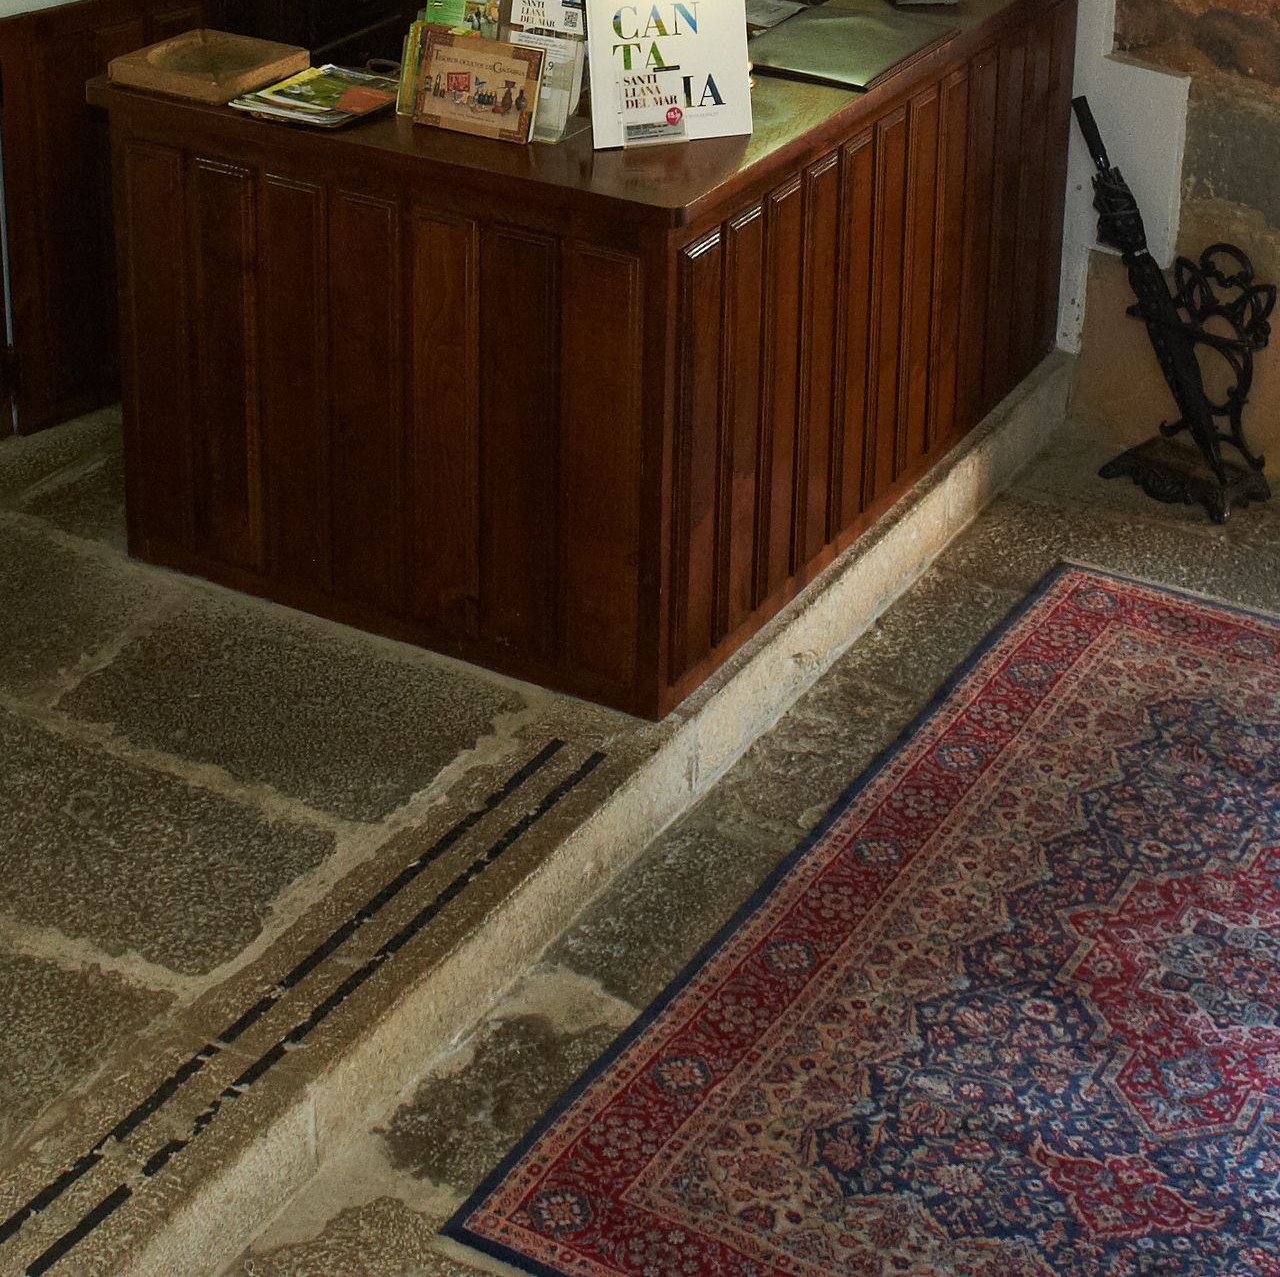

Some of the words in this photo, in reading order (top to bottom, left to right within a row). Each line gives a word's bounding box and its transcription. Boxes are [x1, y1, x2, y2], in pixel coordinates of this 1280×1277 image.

[521, 7, 546, 19] LLANA
[520, 15, 535, 25] DEL
[538, 17, 555, 27] MAR
[612, 1, 700, 40] CAN
[612, 40, 666, 71] TA
[623, 74, 657, 86] SANTI
[624, 85, 661, 98] LLANA
[625, 98, 651, 109] DEL
[653, 95, 678, 106] MAR
